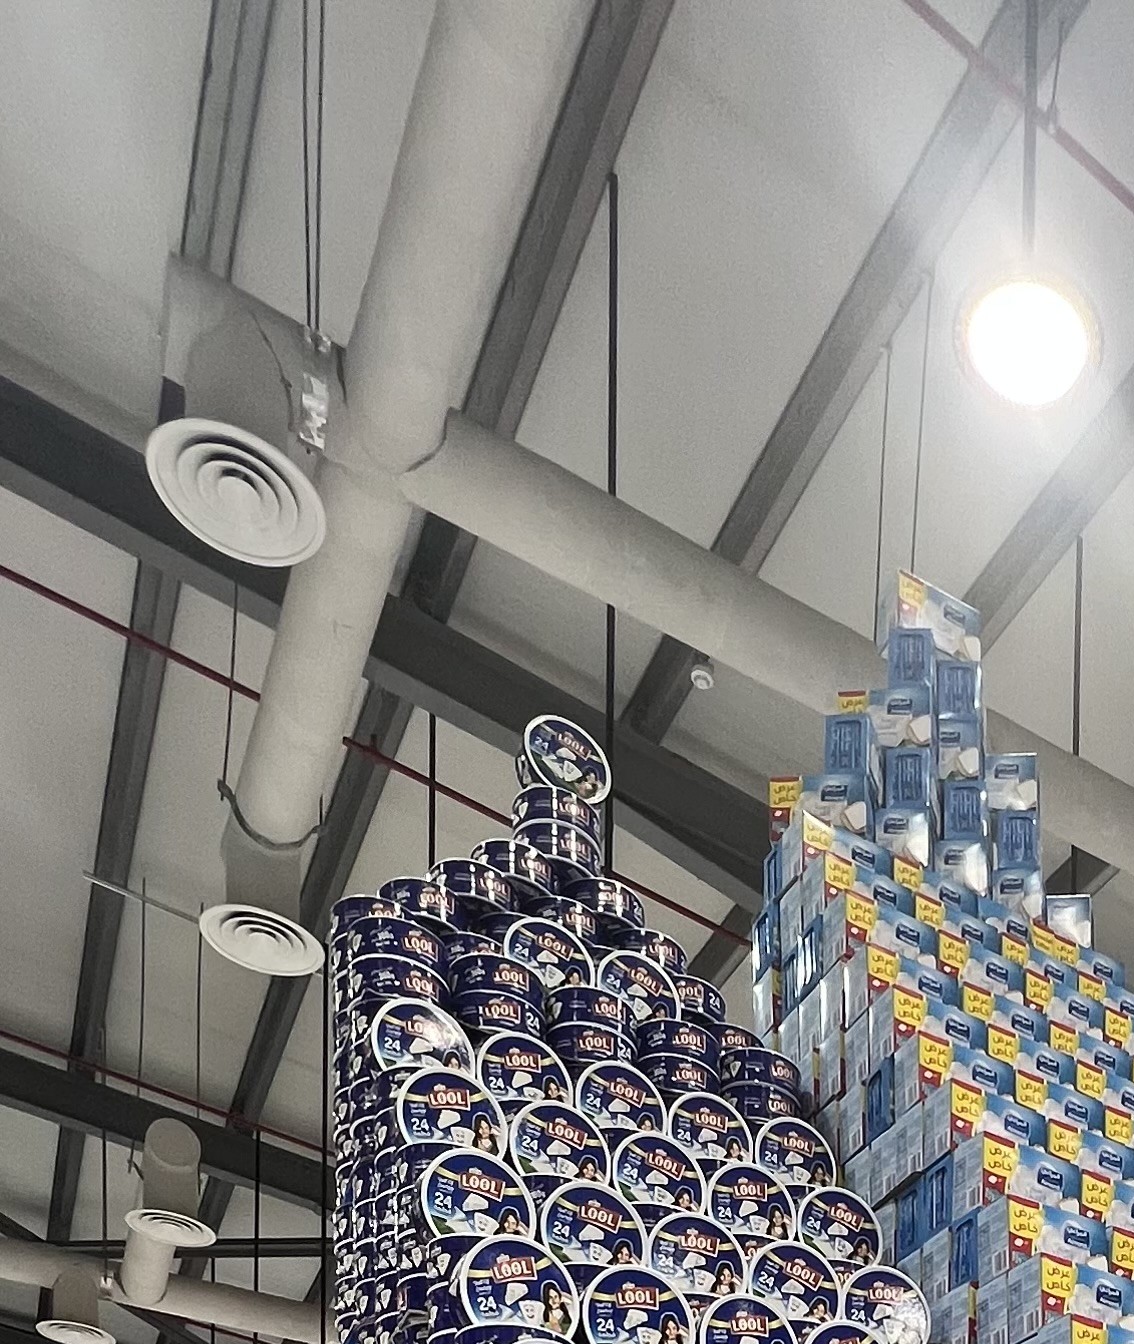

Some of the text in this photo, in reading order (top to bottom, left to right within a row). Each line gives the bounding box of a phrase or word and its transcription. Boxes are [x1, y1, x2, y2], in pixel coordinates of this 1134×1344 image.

[534, 736, 549, 750] 24
[558, 733, 587, 758] LOOL
[429, 1092, 466, 1106] LOOL
[411, 1118, 429, 1131] 24
[695, 1113, 725, 1129] LOOL
[463, 1175, 500, 1194] LOOL
[734, 1185, 763, 1198] LOOL
[494, 1262, 532, 1279] LOOL
[477, 1296, 496, 1310] 24
